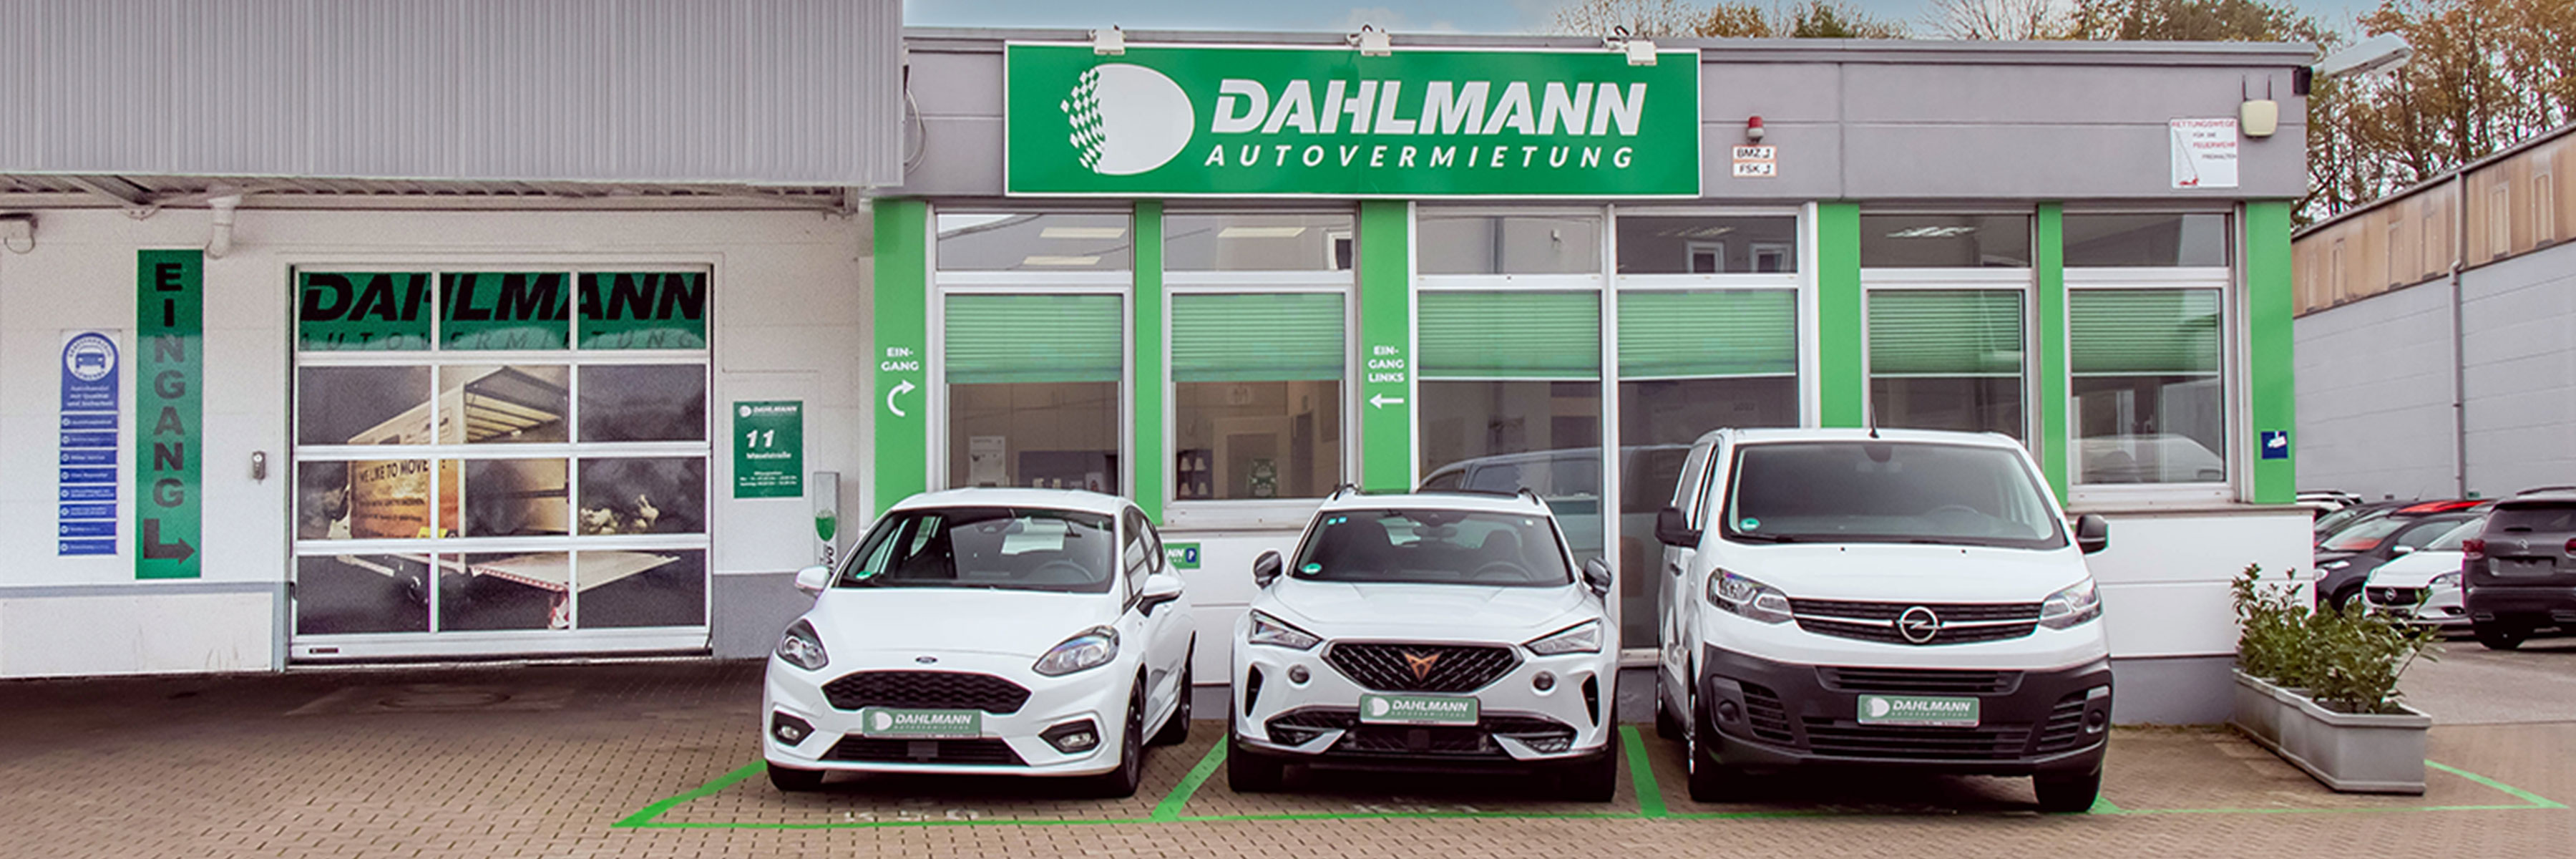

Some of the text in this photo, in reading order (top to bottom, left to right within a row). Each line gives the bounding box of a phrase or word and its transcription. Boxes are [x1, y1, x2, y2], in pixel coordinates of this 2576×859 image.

[1211, 78, 1647, 137] DAHLMANN
[1205, 143, 1634, 169] AUTOVERMIETUNG
[1737, 147, 1761, 157] BMZ
[300, 273, 706, 321] DAHLMANN
[887, 346, 914, 357] EIN-
[1374, 345, 1399, 356] EIN-
[881, 360, 919, 372] GANG
[1367, 359, 1405, 369] GANG
[1368, 372, 1405, 382] LINKS
[153, 262, 184, 508] EINGANG
[746, 430, 774, 448] 11
[1392, 699, 1468, 712] DAHLMANN
[1893, 699, 1971, 712] DAHLMANN
[895, 714, 972, 724] DAHLMANN
